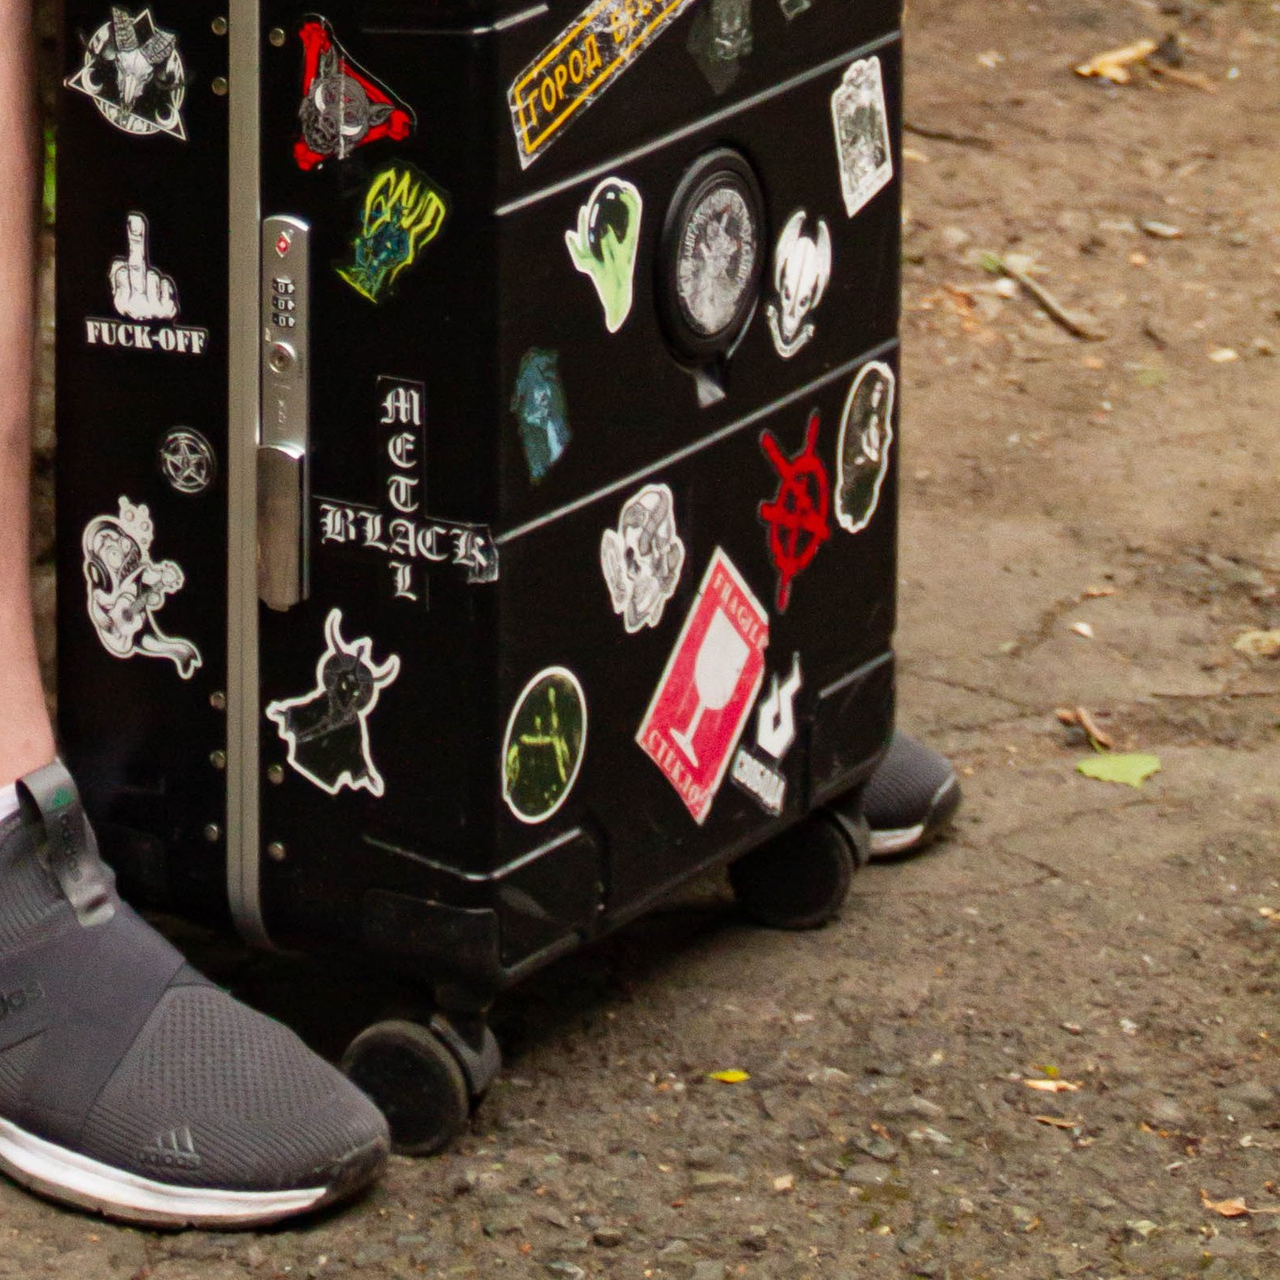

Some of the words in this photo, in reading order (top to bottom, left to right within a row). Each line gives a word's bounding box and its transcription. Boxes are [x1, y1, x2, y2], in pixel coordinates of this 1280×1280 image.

[527, 33, 603, 127] ГОРОД
[86, 319, 206, 355] FUCK-OFF
[380, 387, 422, 602] METAL
[320, 504, 488, 568] BLACK
